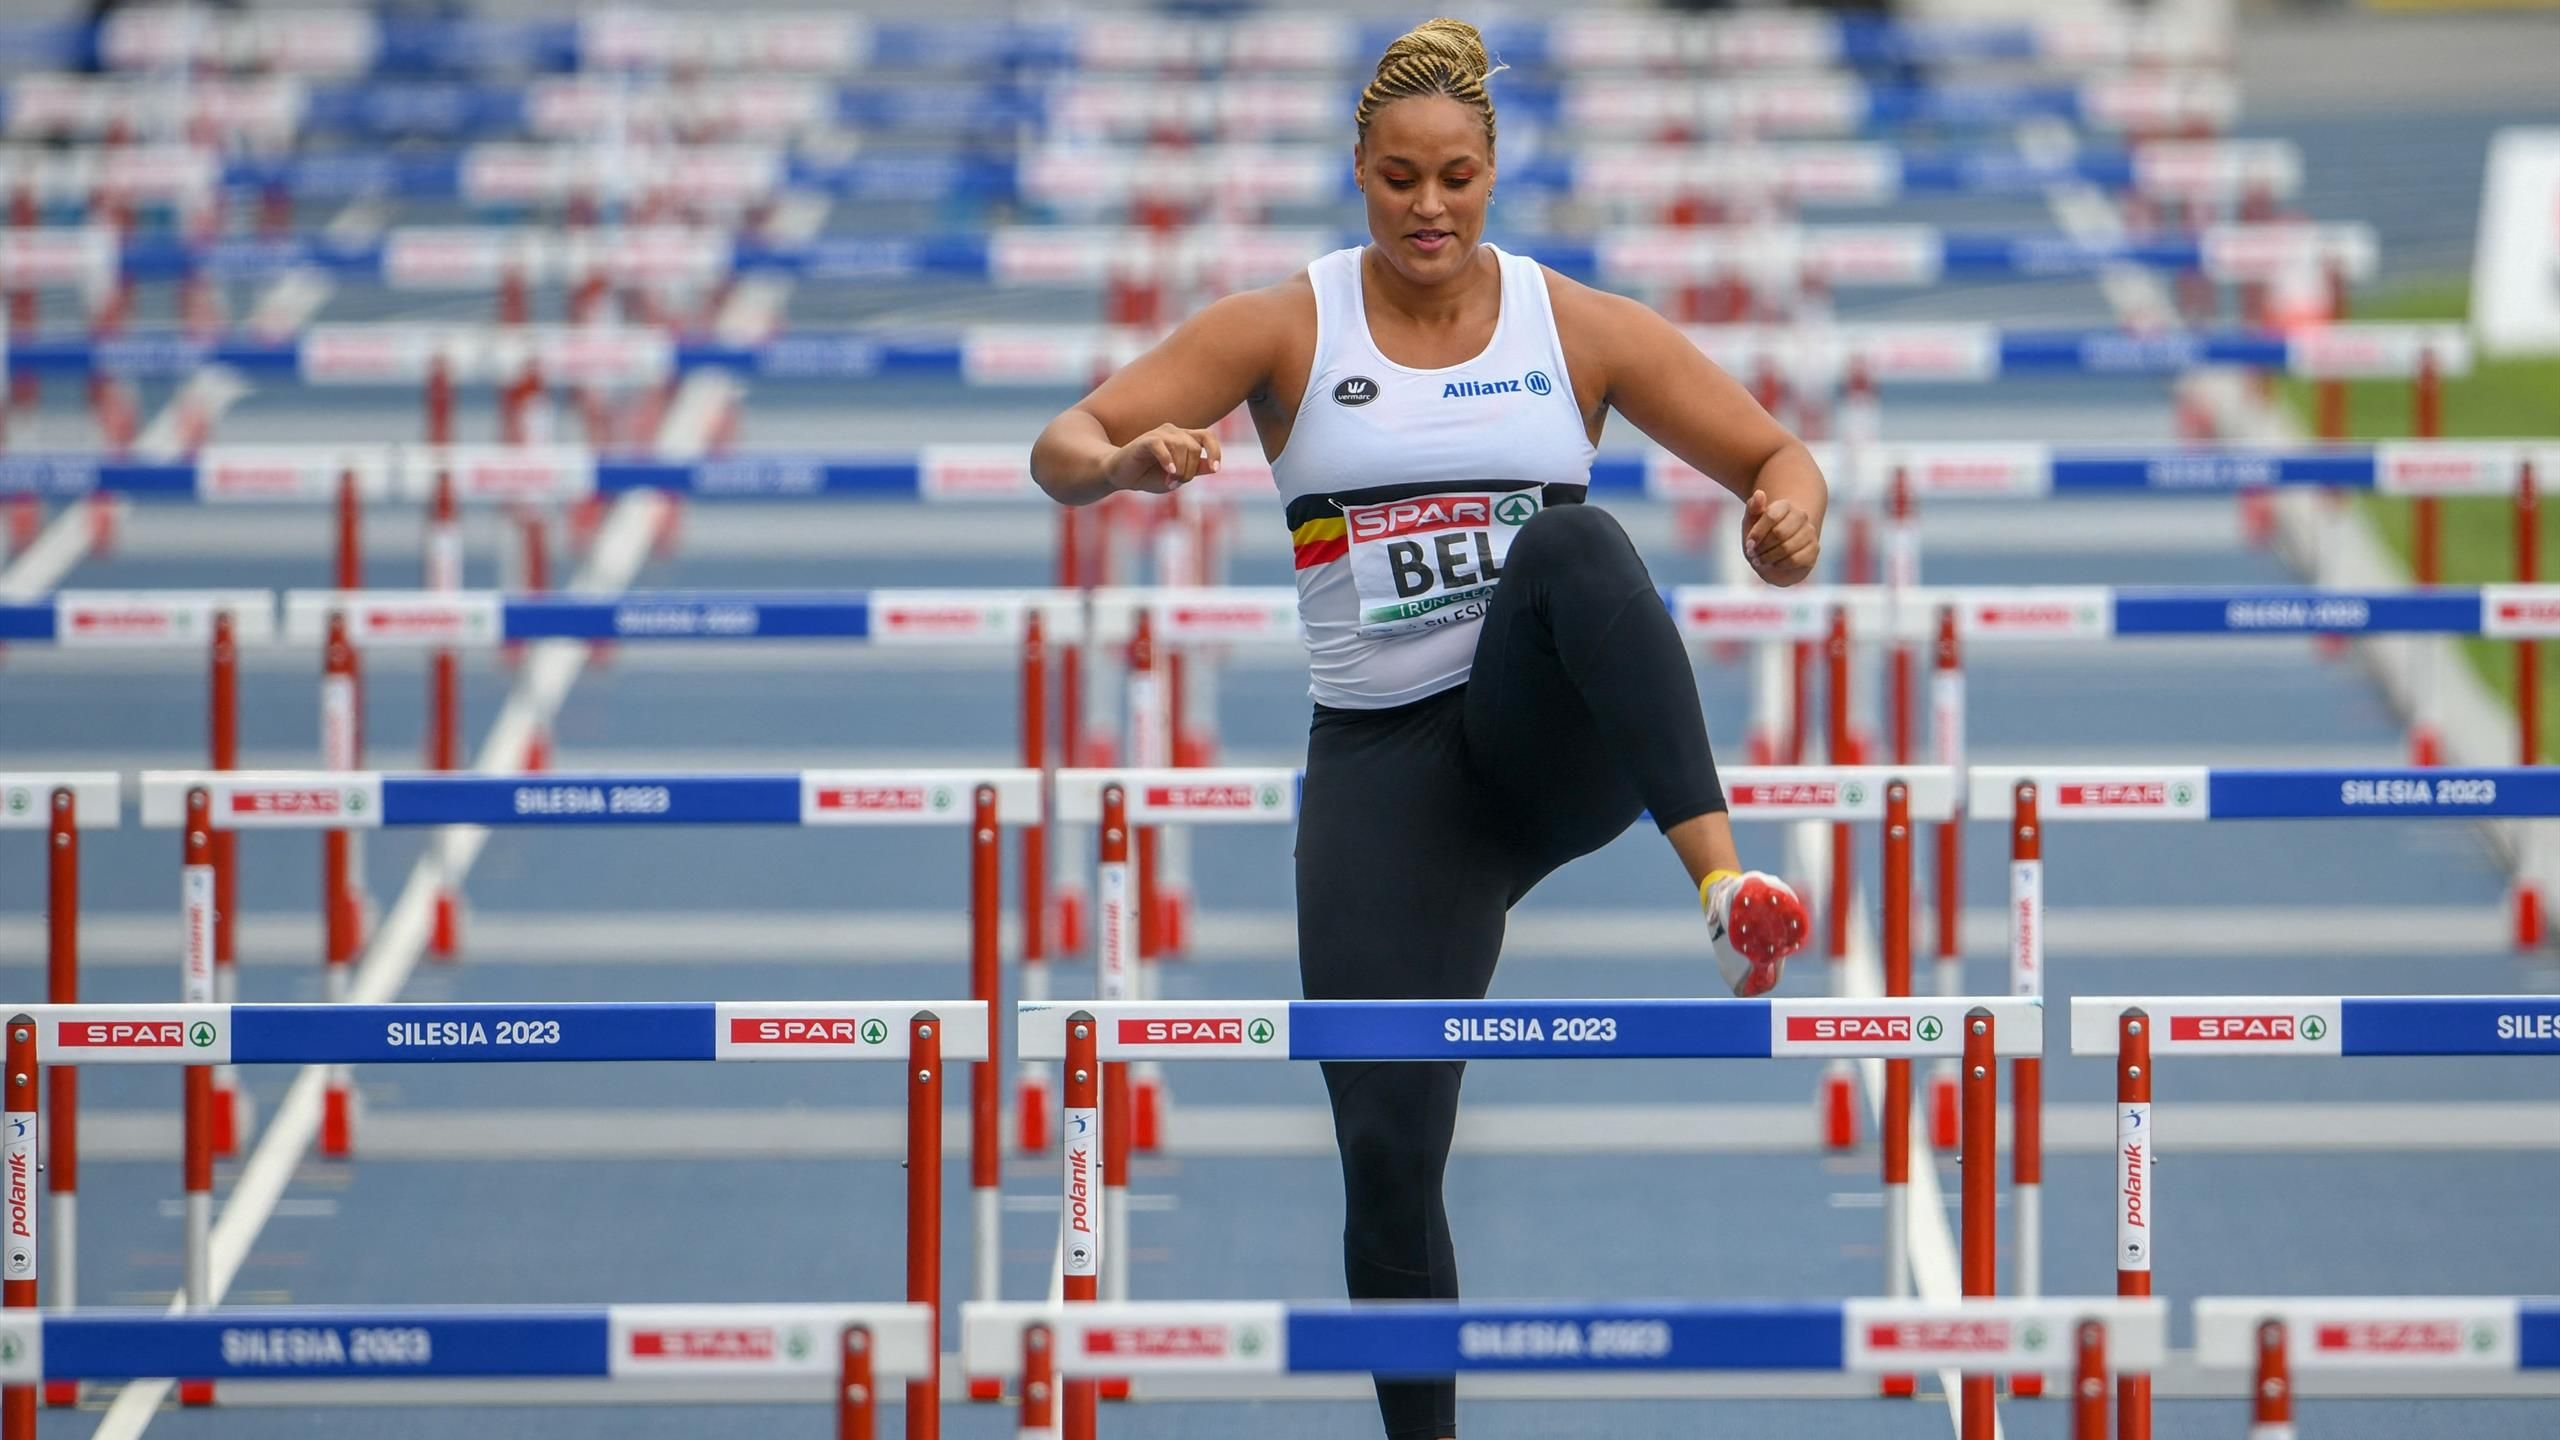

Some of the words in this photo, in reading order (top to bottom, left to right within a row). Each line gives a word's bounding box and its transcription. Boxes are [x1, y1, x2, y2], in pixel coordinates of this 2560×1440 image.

[1337, 393, 1371, 401] vermarc
[1442, 379, 1522, 399] Allianz
[1354, 502, 1487, 537] SPAR
[1387, 532, 1504, 598] BEL
[1409, 598, 1445, 616] RUN
[1449, 587, 1495, 602] CLEA
[514, 786, 607, 814] SILESIA
[608, 786, 671, 813] 2023
[2340, 779, 2433, 805] SILESIA
[2435, 779, 2497, 805] 2023
[86, 1024, 182, 1043] SPAR
[386, 1022, 489, 1046] SILESIA
[494, 1020, 561, 1045] 2023
[758, 1021, 854, 1041] SPAR
[1145, 1021, 1241, 1041] SPAR
[1443, 1017, 1545, 1042] SILESIA
[1551, 1017, 1618, 1041] 2023
[1813, 1019, 1909, 1038] SPAR
[2197, 1018, 2293, 1038] SPAR
[8, 1151, 31, 1238] polanik
[1068, 1147, 1091, 1233] polanik
[2123, 1142, 2145, 1228] polanik
